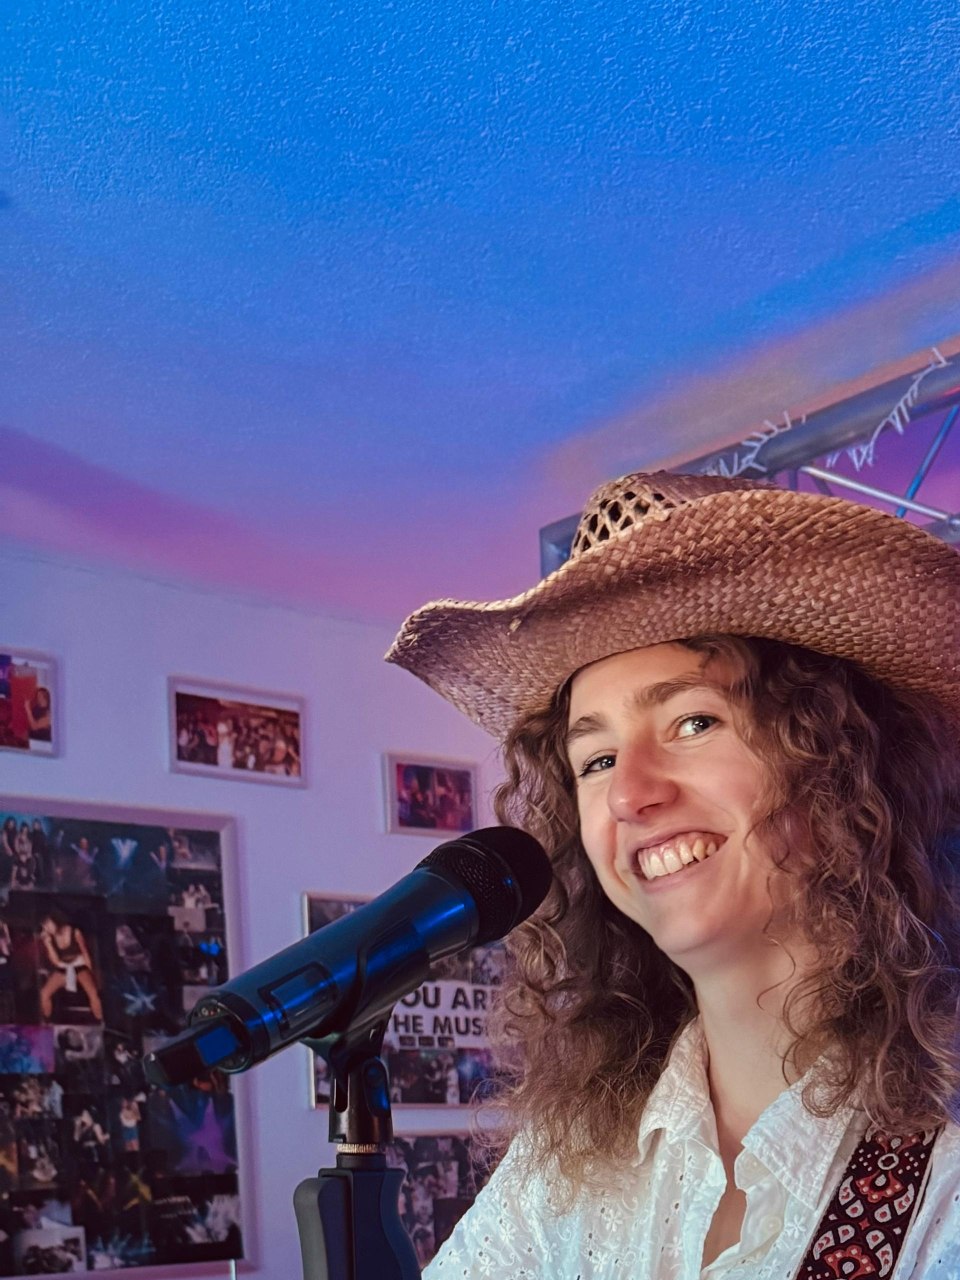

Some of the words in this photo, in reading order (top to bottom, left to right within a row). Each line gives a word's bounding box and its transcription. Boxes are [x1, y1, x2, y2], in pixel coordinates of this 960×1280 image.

[401, 986, 441, 1010] OU
[388, 1014, 424, 1034] HE
[432, 1015, 489, 1036] MUS
